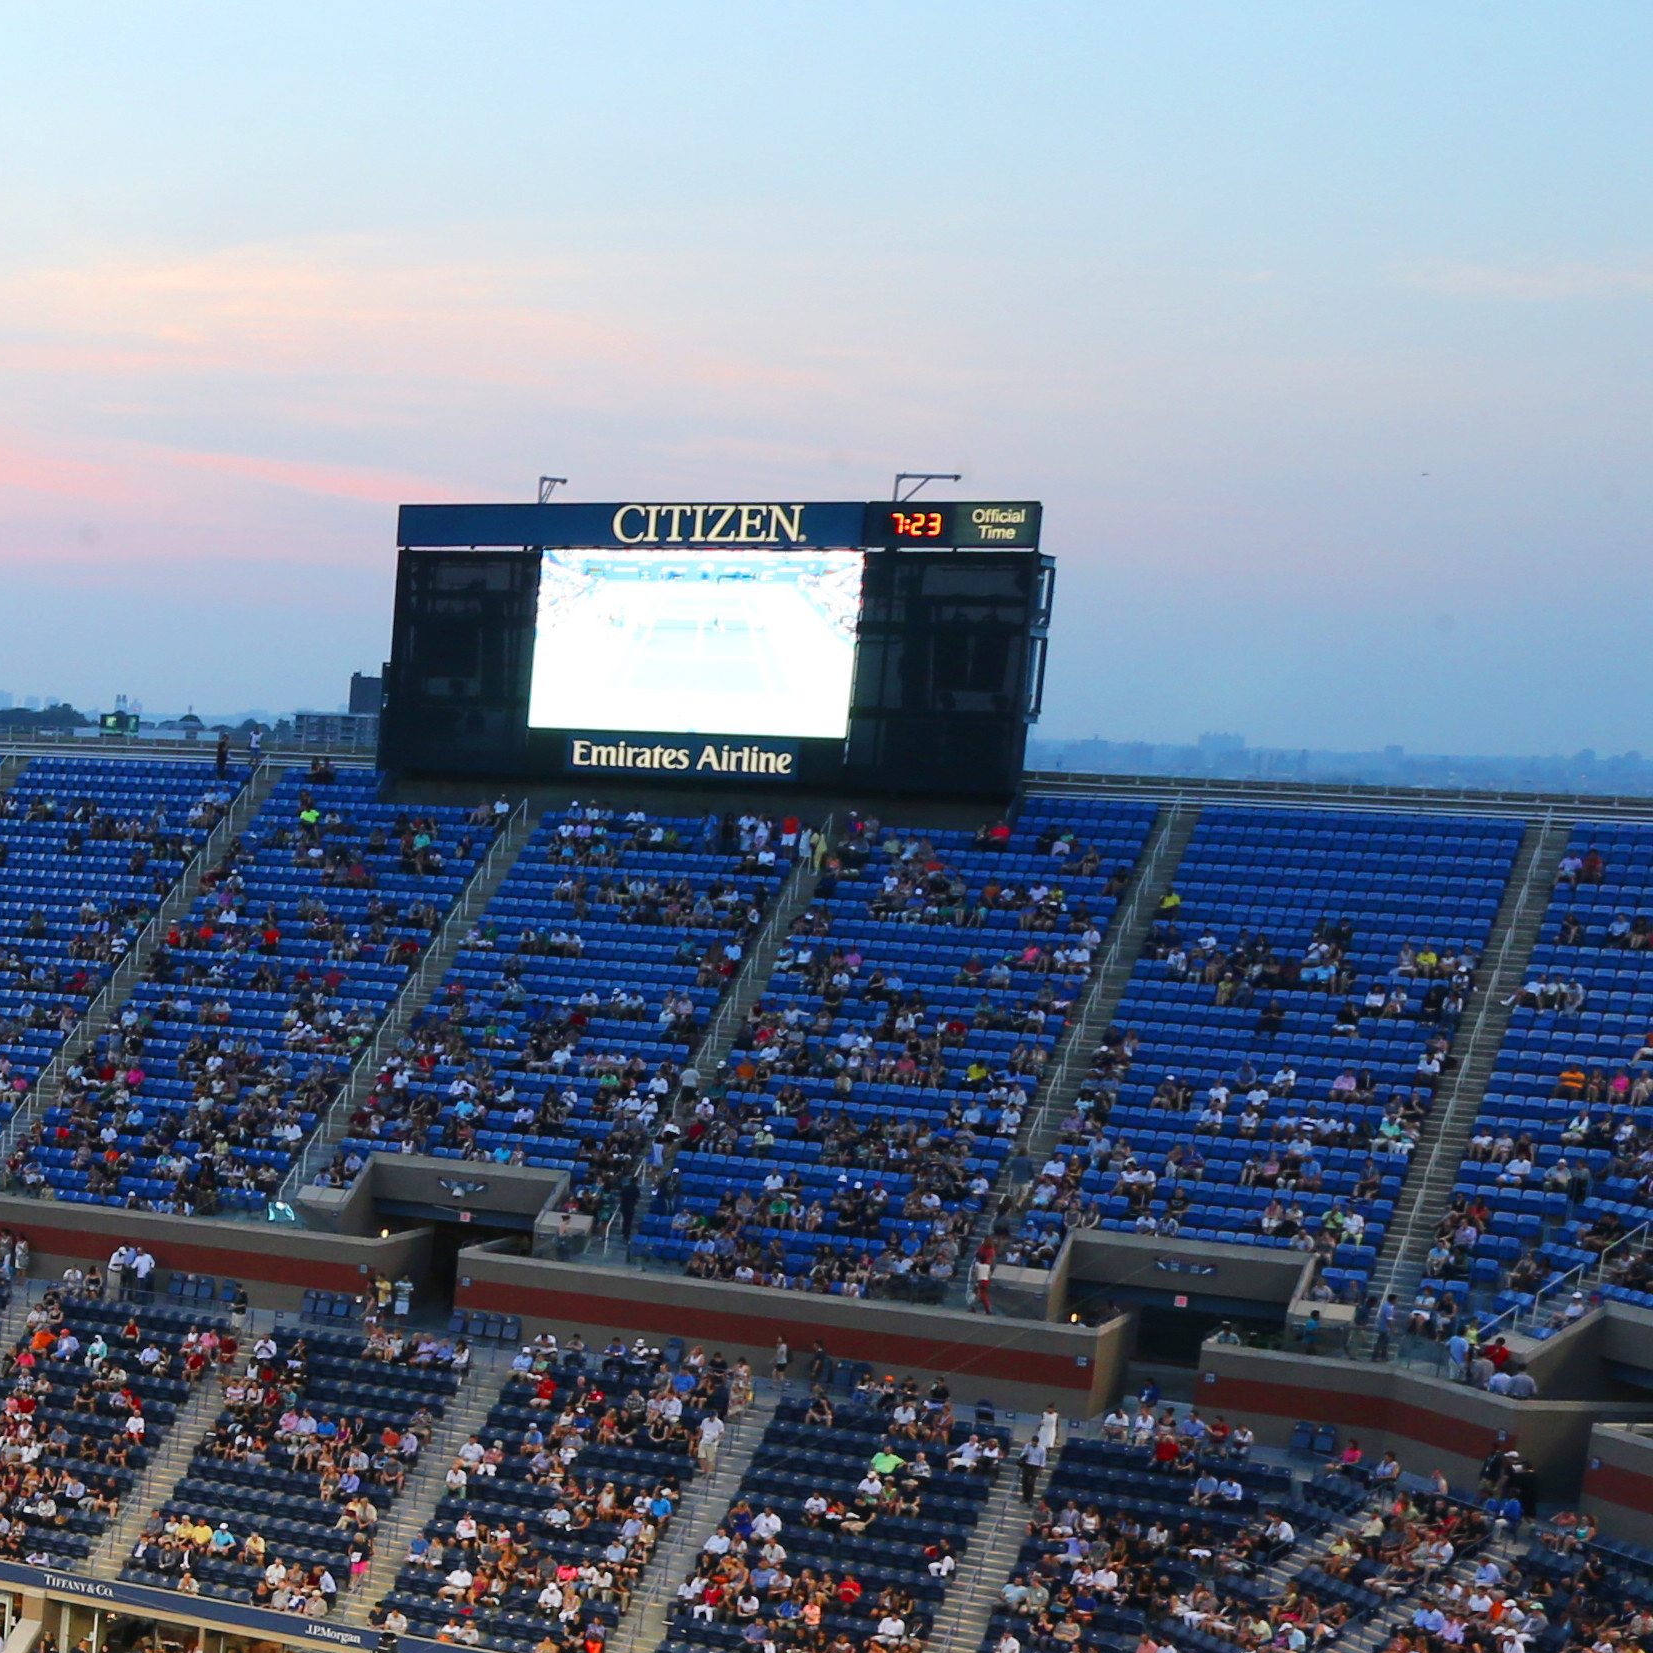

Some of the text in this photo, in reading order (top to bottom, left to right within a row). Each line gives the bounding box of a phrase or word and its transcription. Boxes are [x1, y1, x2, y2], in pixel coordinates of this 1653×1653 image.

[891, 512, 942, 536] 7:23
[972, 508, 1025, 525] Official
[978, 525, 1016, 540] Time
[572, 740, 793, 774] Emirates Airline
[305, 1624, 361, 1645] J.P.Morgan
